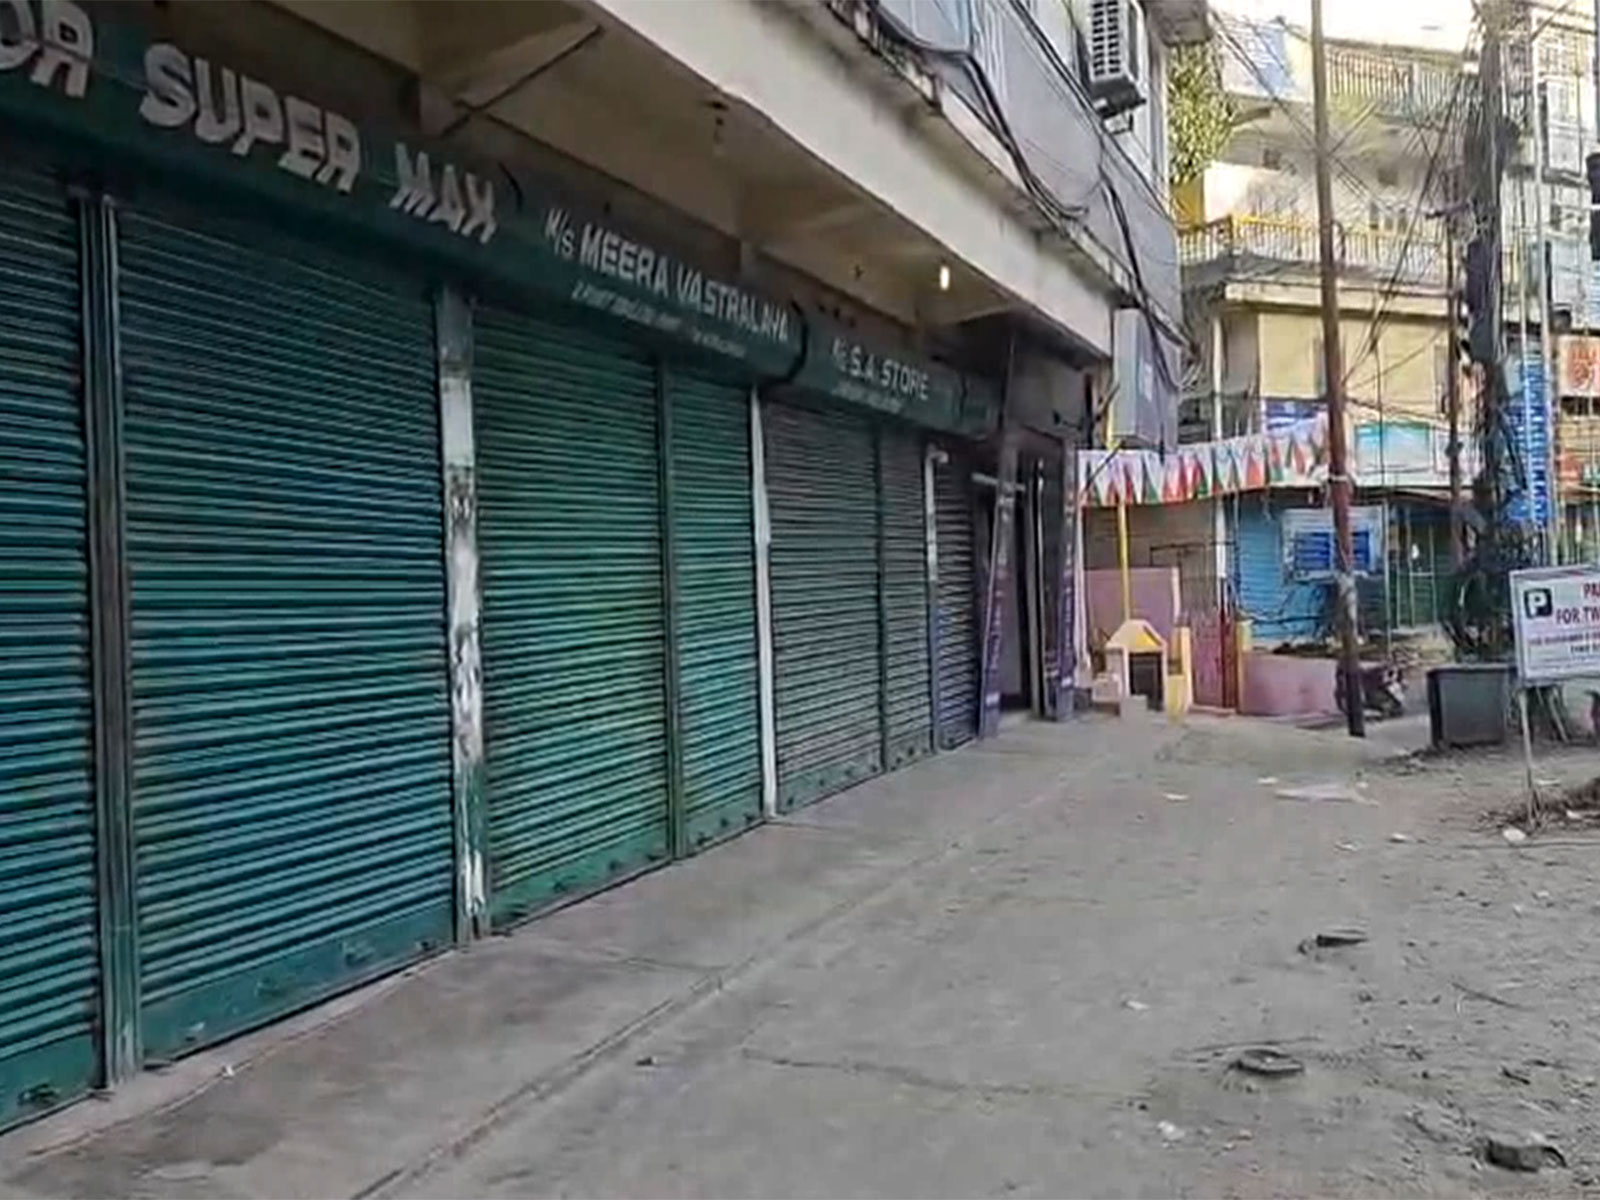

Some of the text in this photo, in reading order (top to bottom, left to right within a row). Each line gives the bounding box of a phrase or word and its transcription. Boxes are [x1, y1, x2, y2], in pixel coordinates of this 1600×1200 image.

[139, 43, 361, 193] SUPER
[389, 142, 498, 244] MAX
[580, 222, 669, 298] MEERA
[676, 264, 789, 343] VASTRALAYA
[880, 358, 930, 401] STORE
[1556, 606, 1581, 625] FOR
